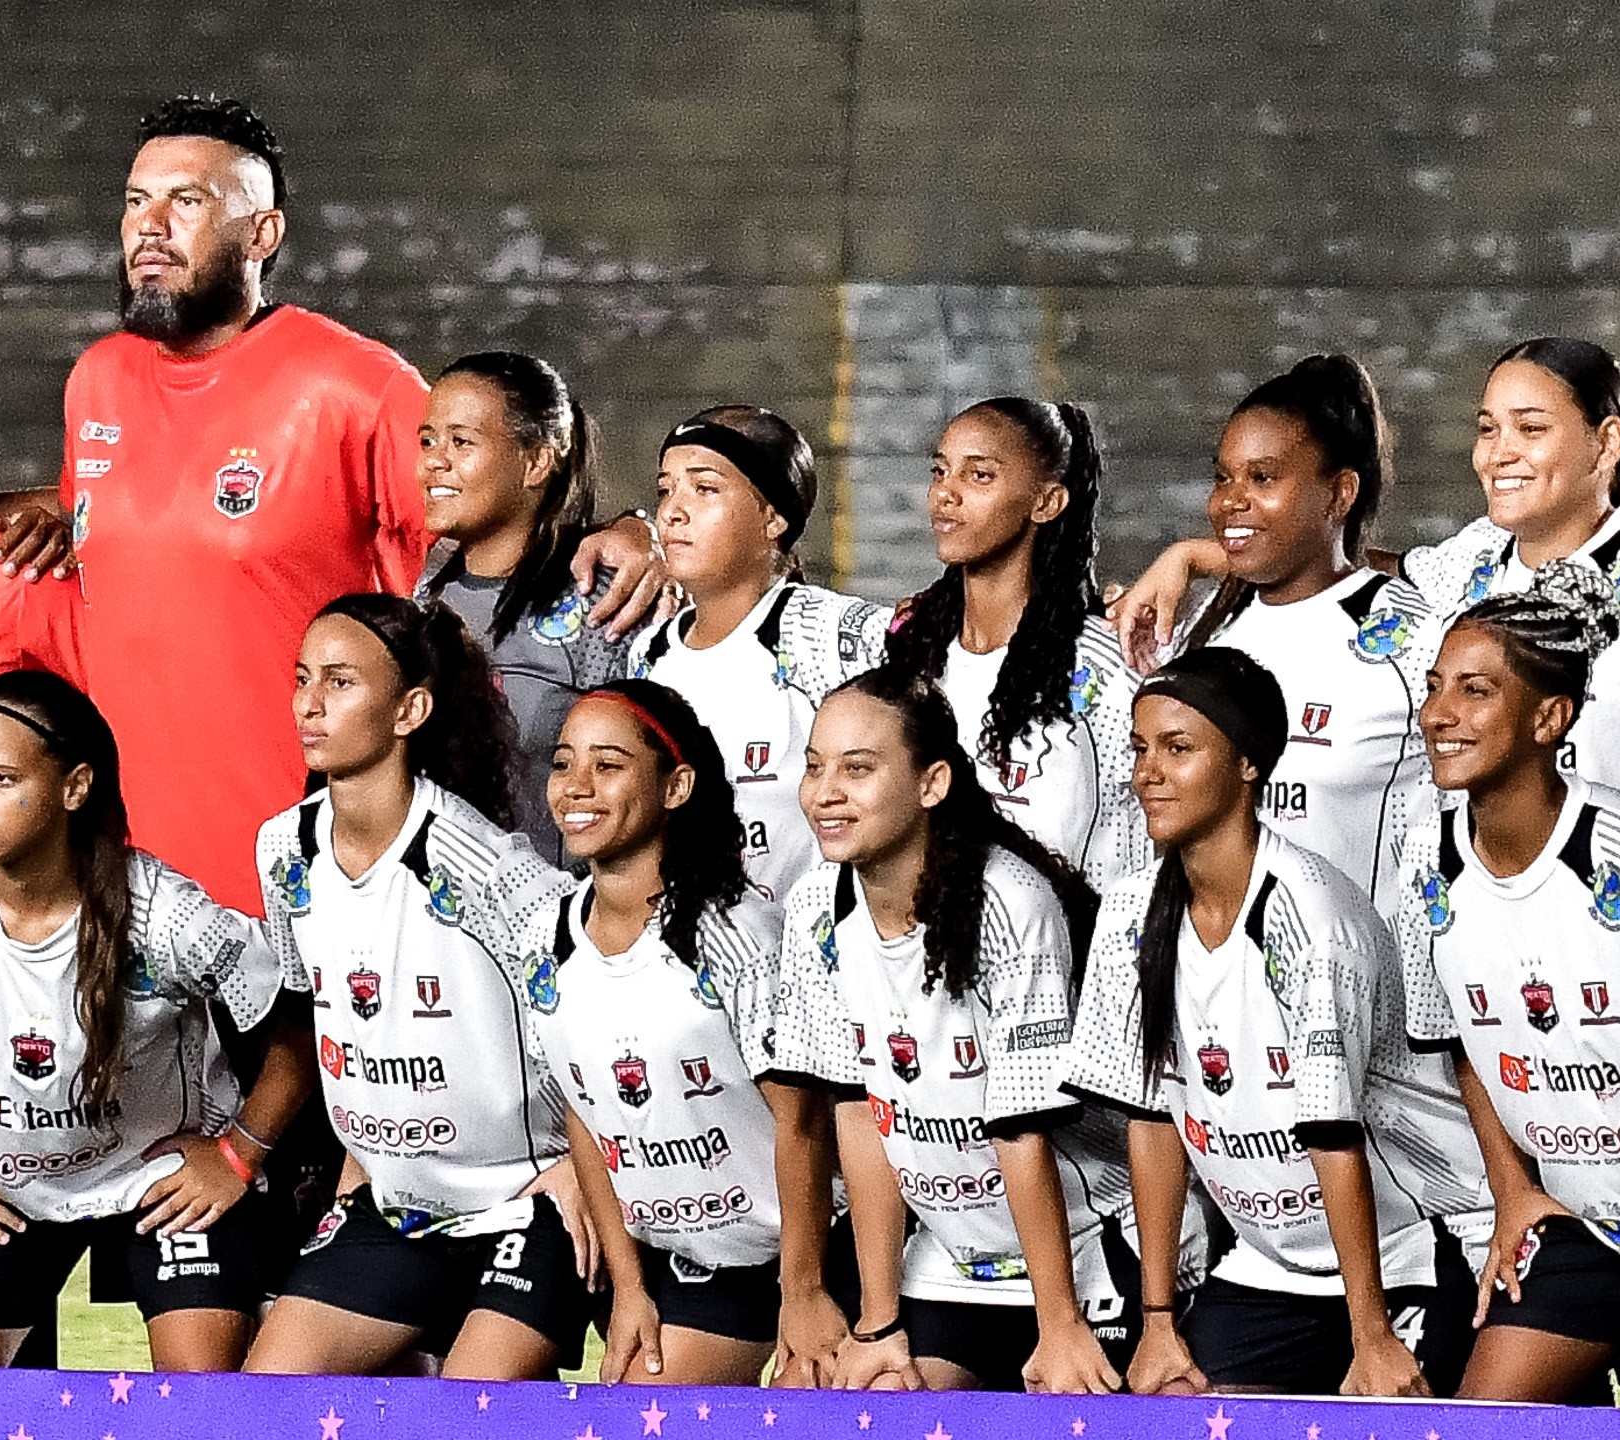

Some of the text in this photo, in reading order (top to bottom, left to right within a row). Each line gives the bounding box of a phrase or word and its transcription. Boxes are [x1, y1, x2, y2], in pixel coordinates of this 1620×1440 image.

[634, 1188, 749, 1222] LOTEP
[493, 1232, 527, 1269] 8
[1388, 1306, 1426, 1353] 4
